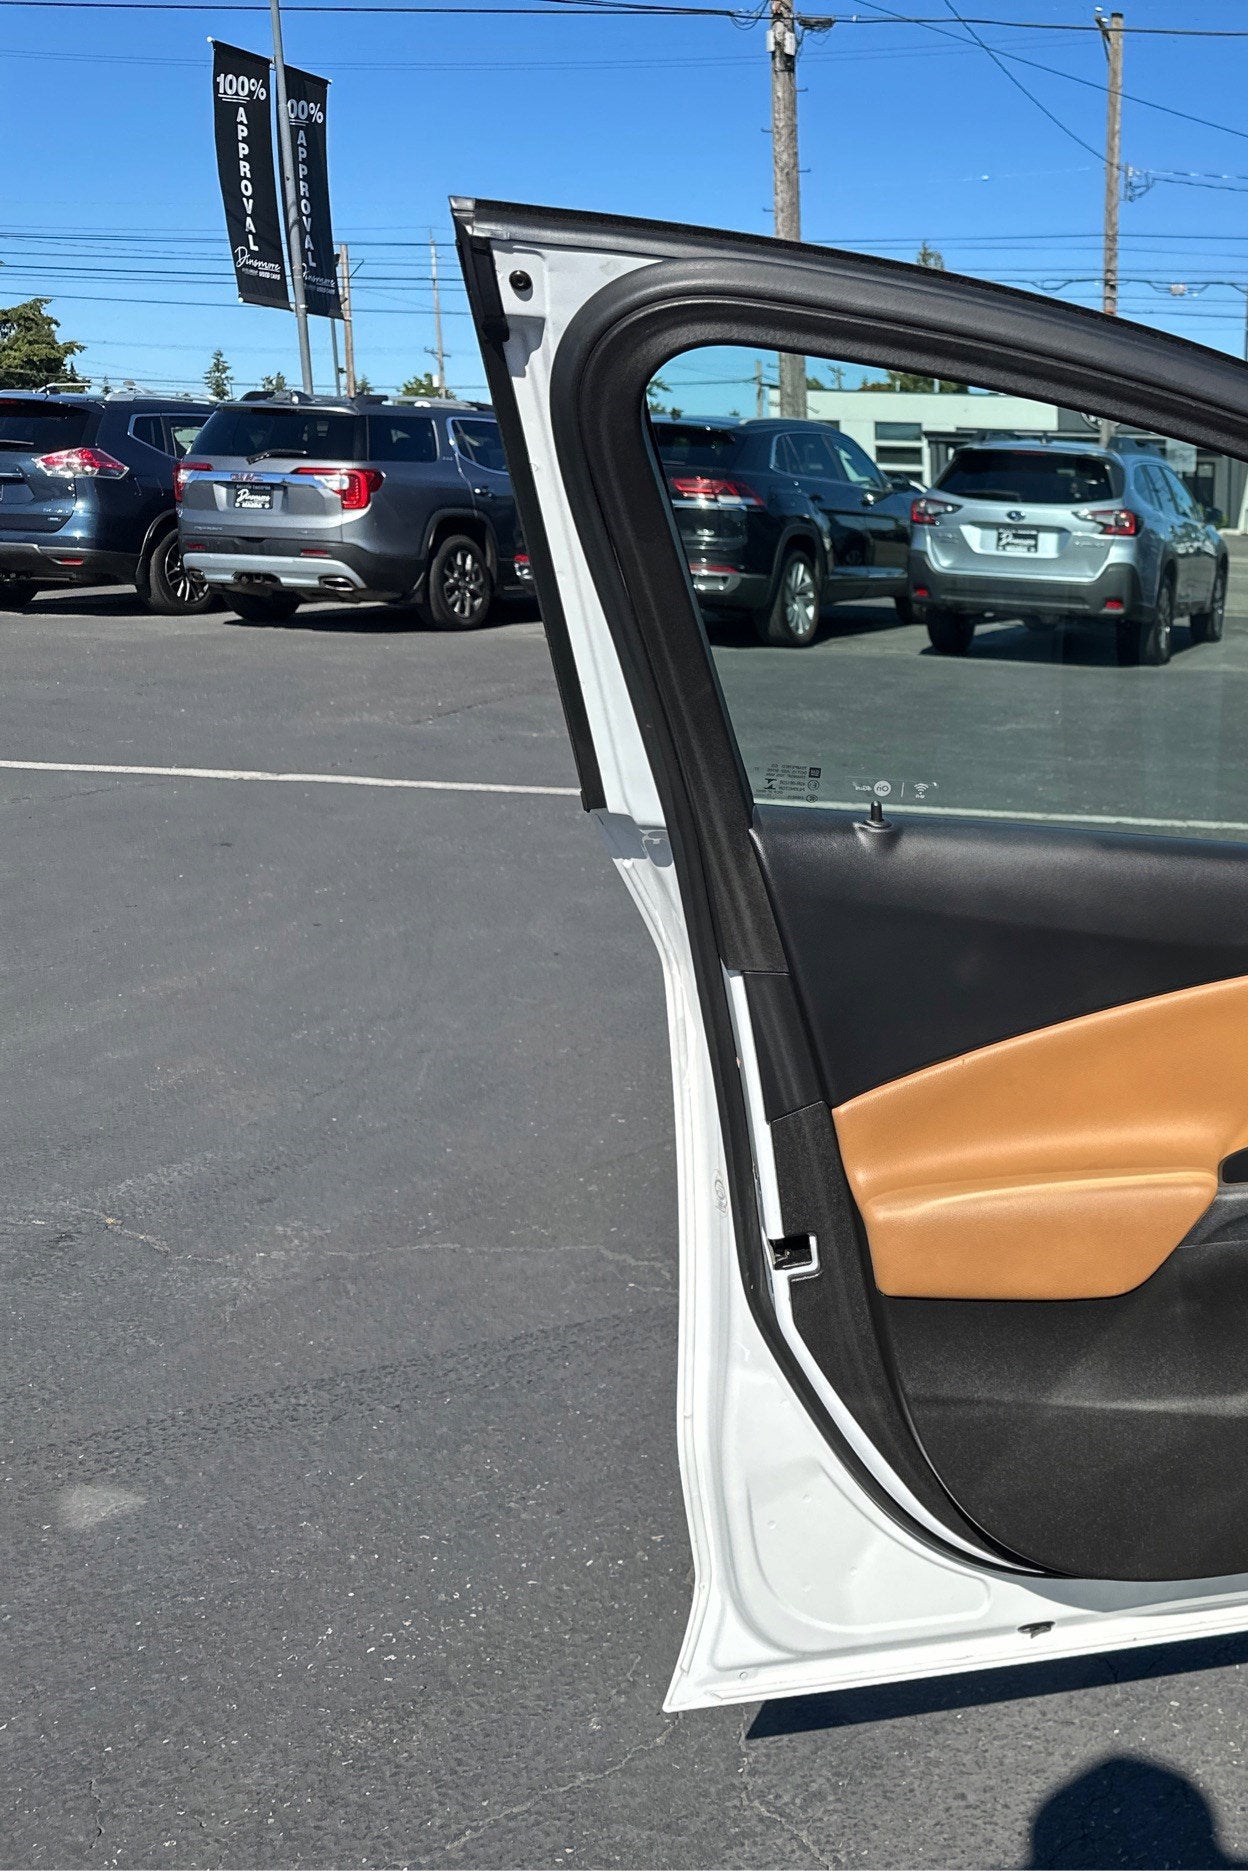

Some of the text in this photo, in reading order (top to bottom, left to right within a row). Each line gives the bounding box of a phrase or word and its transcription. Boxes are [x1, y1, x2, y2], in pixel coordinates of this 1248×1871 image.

[216, 73, 267, 100] 100%
[236, 106, 259, 252] APPROVAL
[296, 129, 317, 268] APPROVAL
